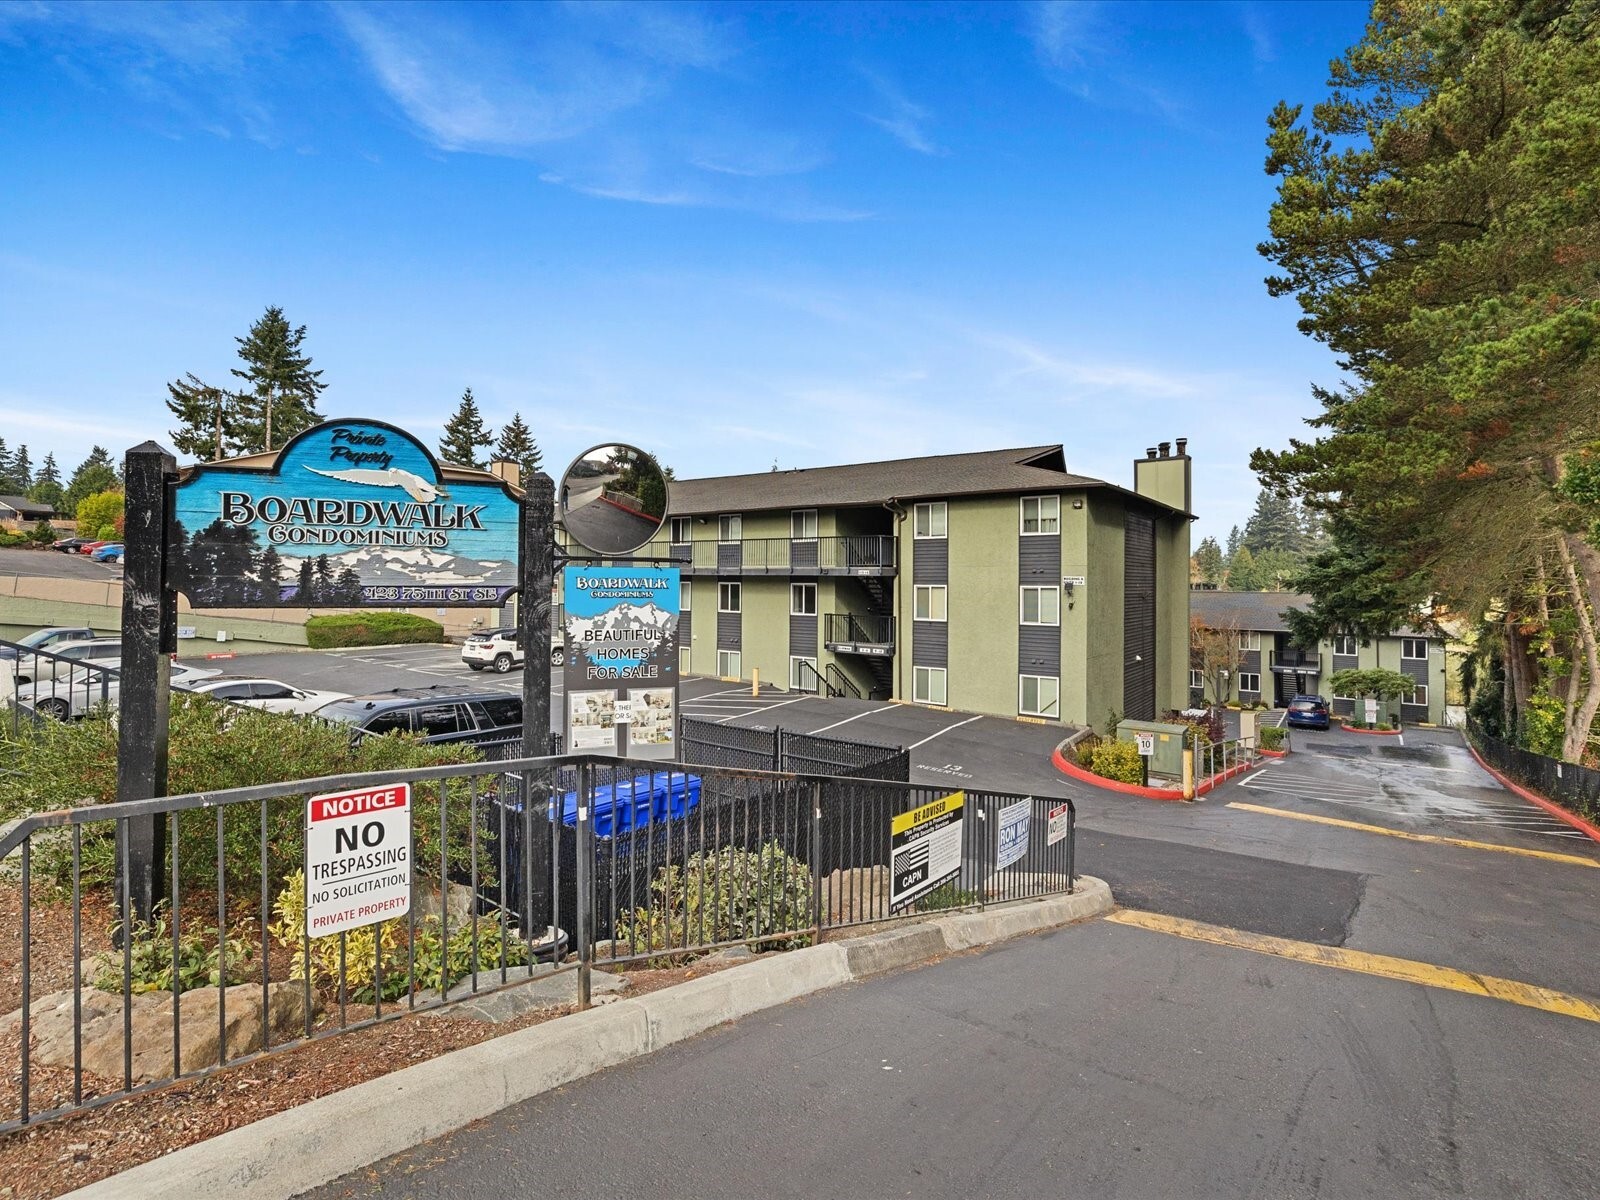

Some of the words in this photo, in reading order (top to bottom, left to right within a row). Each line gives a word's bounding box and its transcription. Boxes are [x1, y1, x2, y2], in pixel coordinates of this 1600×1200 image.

[331, 428, 386, 445] Private
[330, 446, 394, 470] Property
[218, 490, 488, 530] BOARDWALK
[267, 524, 448, 548] CONDOMINIUMS
[576, 576, 669, 589] BOARDWALK
[364, 586, 400, 601] 423
[590, 590, 654, 598] CONDOMINIUMS
[584, 629, 661, 642] BEAUTIFUL
[596, 648, 650, 660] HOMES
[587, 667, 618, 679] FOR
[621, 665, 659, 678] SALE
[1141, 740, 1151, 749] 10
[322, 791, 396, 817] NOTICE
[913, 811, 921, 823] BE
[922, 801, 946, 820] ADVISED
[335, 821, 385, 854] NO
[312, 846, 406, 881] TRESPASSING
[902, 869, 922, 887] CAPN
[312, 891, 329, 904] NO
[333, 873, 406, 900] SOLICITATION
[313, 909, 356, 928] PRIVATE
[358, 896, 407, 917] PROPERTY
